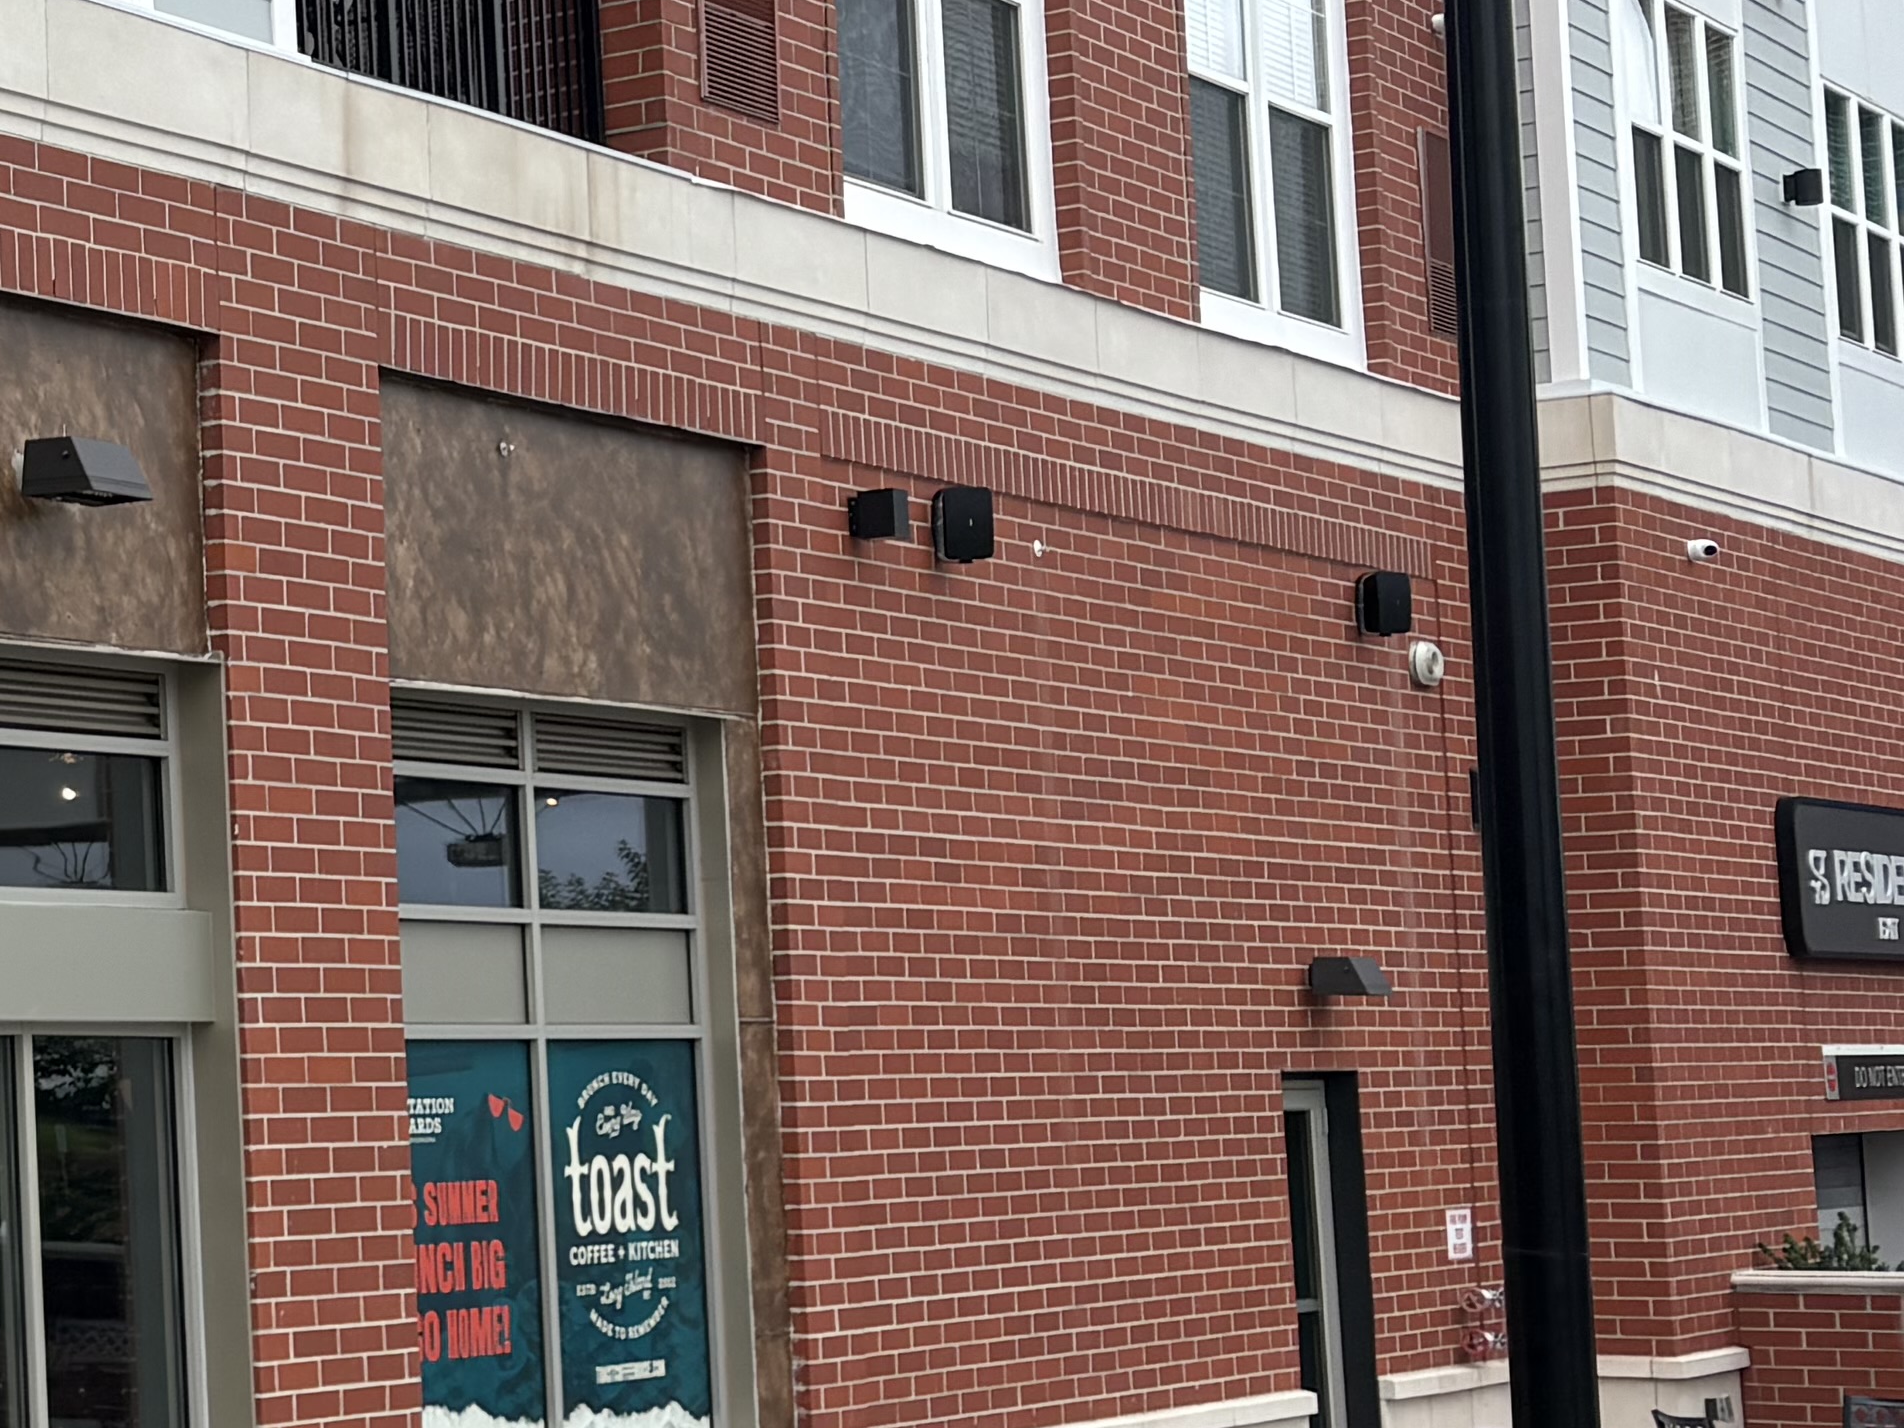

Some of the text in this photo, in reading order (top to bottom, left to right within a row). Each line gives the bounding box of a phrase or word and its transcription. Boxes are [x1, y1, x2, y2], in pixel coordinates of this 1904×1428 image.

[611, 1071, 640, 1090] EVERY
[641, 1083, 658, 1107] DAY
[564, 1114, 679, 1237] toast
[423, 1180, 499, 1226] SUMMER
[471, 1239, 506, 1290] BIG
[569, 1243, 616, 1265] COFFEE
[628, 1239, 679, 1261] KITCHEN
[446, 1305, 512, 1359] HOME!
